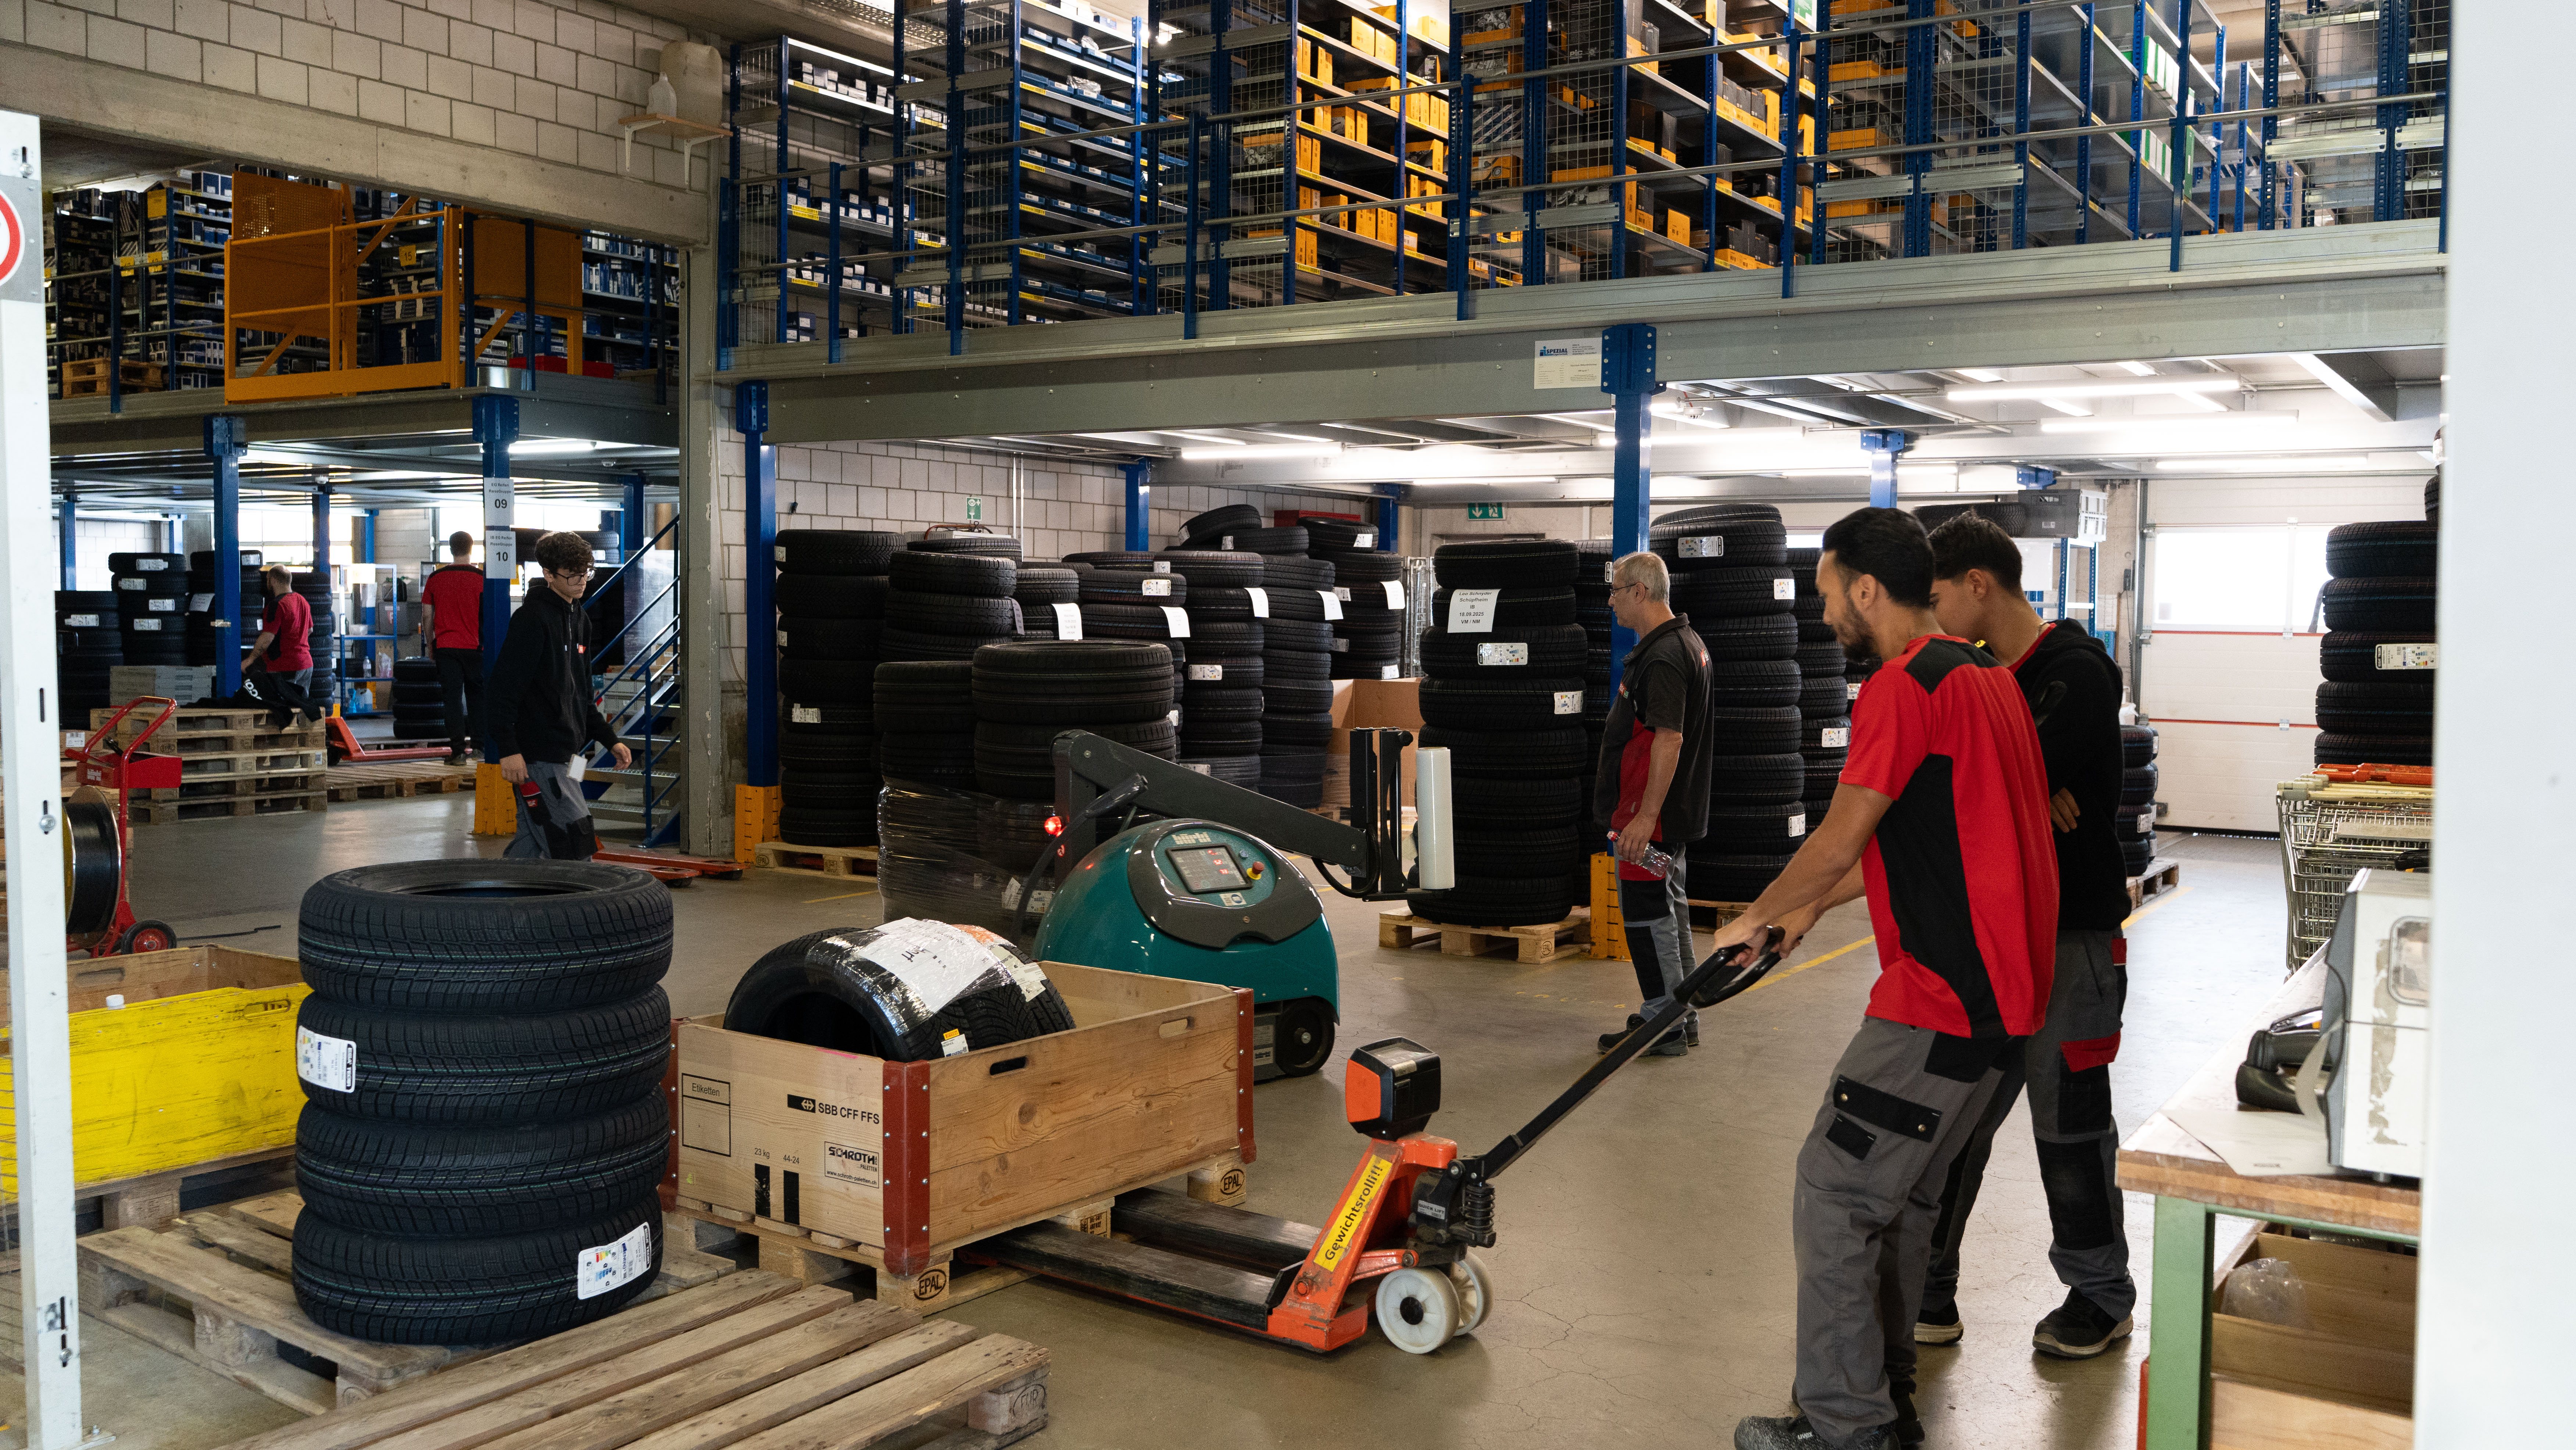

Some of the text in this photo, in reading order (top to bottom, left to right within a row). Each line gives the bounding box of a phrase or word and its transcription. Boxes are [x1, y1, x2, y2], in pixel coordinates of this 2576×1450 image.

[405, 252, 412, 261] 15
[495, 499, 507, 508] 09
[496, 552, 508, 561] 10
[692, 1082, 720, 1097] Etiketten
[818, 1103, 880, 1124] SBB CFF FFS
[755, 1147, 770, 1160] 23 kg
[783, 1155, 799, 1164] 44-24
[829, 1146, 875, 1165] SCHROTH
[827, 1171, 877, 1185] www.schroth-paletten.ch
[1224, 1174, 1242, 1191] EPAL
[1325, 1165, 1383, 1260] Gewichtsrolli!!
[919, 1275, 942, 1296] EPAL
[1797, 1431, 1813, 1440] uvex
